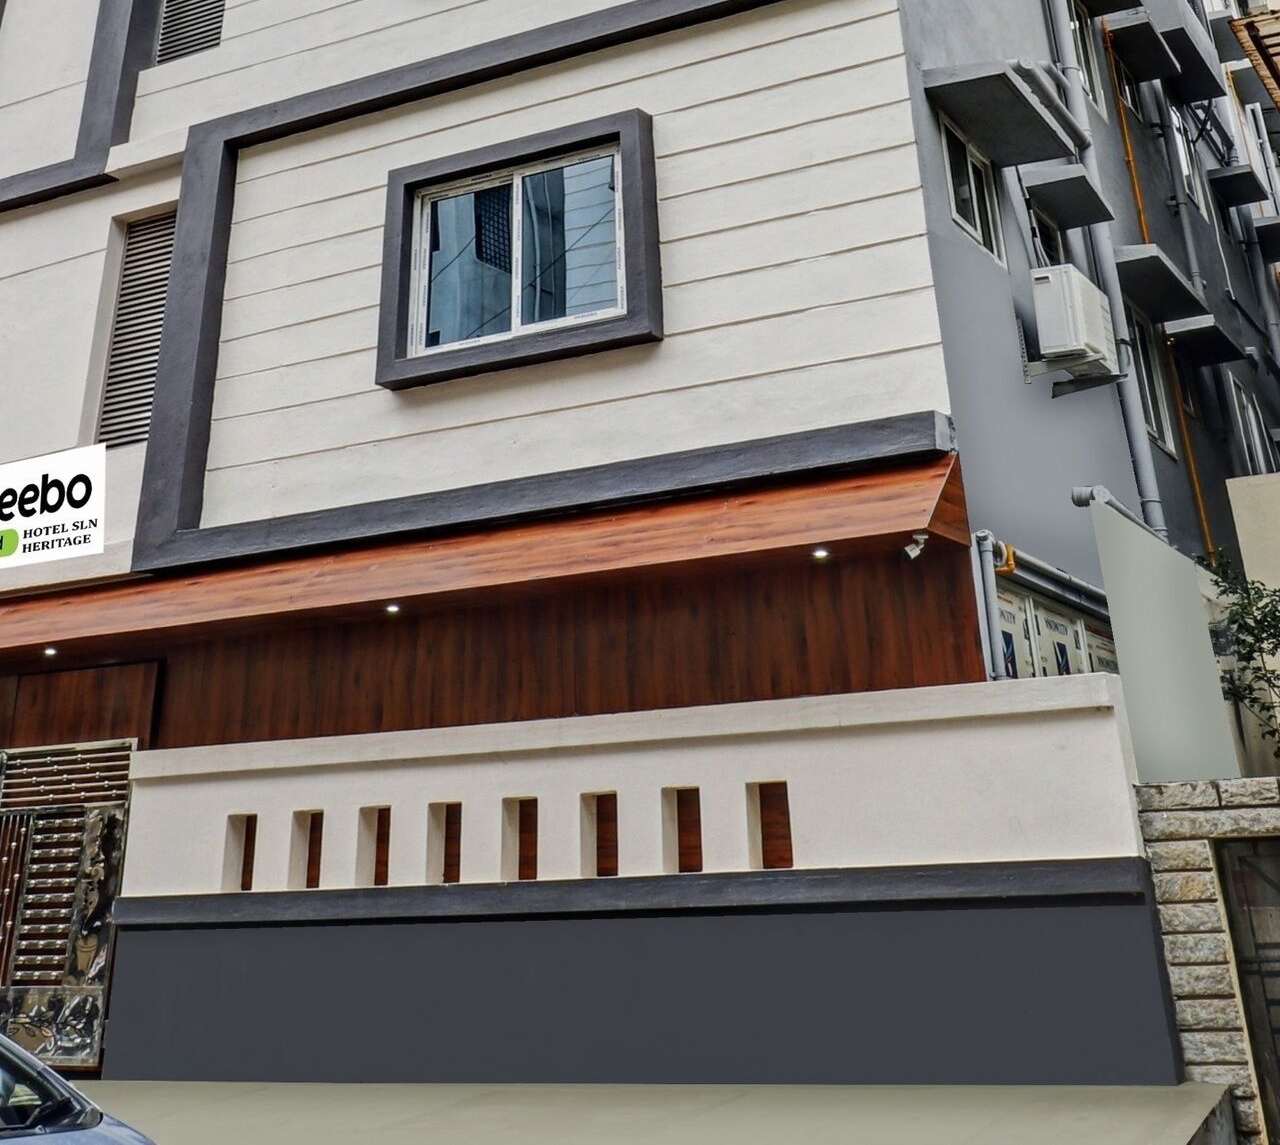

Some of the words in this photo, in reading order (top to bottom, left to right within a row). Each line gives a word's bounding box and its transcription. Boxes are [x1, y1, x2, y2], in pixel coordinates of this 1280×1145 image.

[23, 522, 68, 539] HOTEL
[72, 518, 98, 531] SLN
[22, 534, 92, 553] HERITAGE
